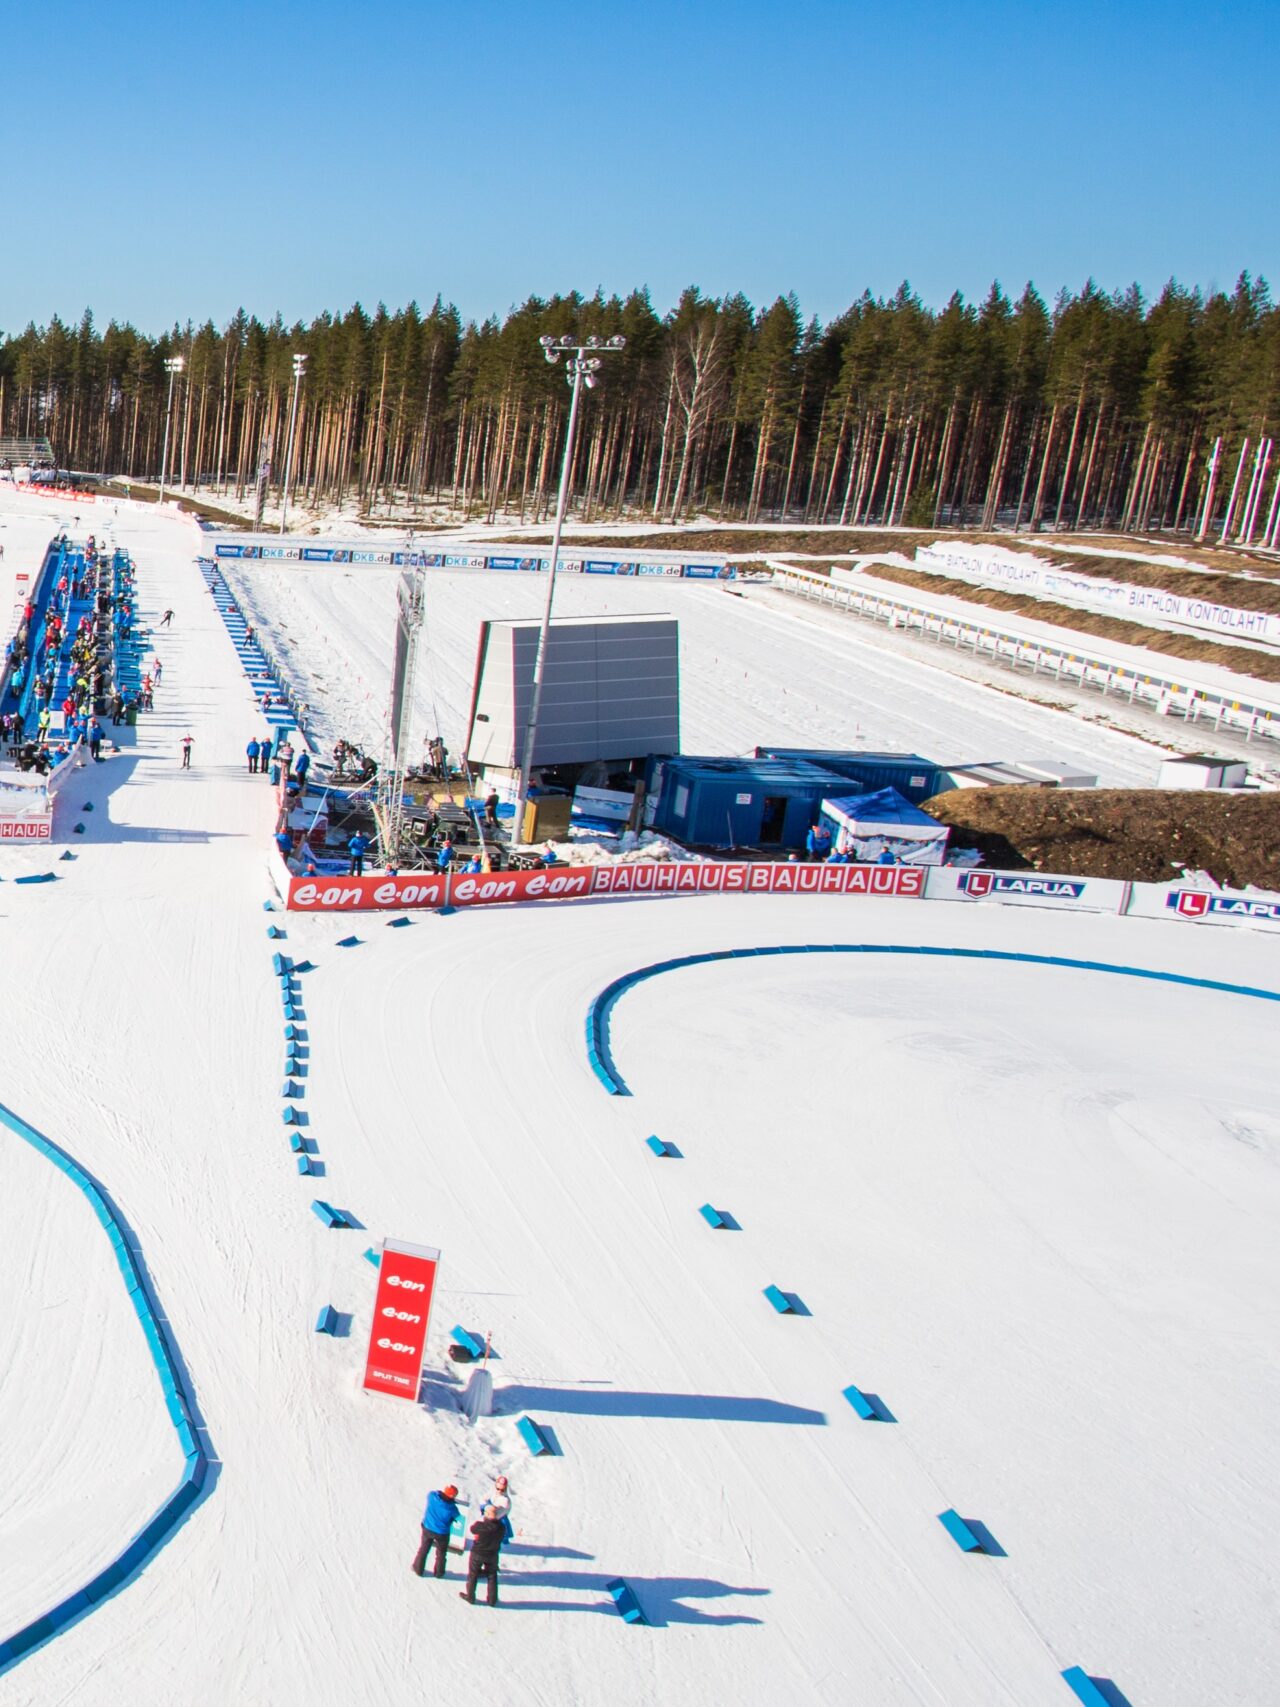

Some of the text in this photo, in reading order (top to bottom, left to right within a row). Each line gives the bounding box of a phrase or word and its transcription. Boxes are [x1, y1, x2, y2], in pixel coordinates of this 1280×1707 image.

[263, 549, 299, 559] DKB.de
[353, 553, 390, 562] DKB.de
[446, 556, 484, 567] DKB.de
[541, 561, 580, 571] DB.de
[639, 565, 680, 575] DKB.de
[1128, 591, 1269, 633] BIATHLON KONTIOLAHTI
[594, 867, 744, 890] BAUHAUS
[751, 868, 919, 893] BAUHAUS
[995, 878, 1076, 897] LAPUA
[372, 1370, 410, 1386] SPLIT TIME
